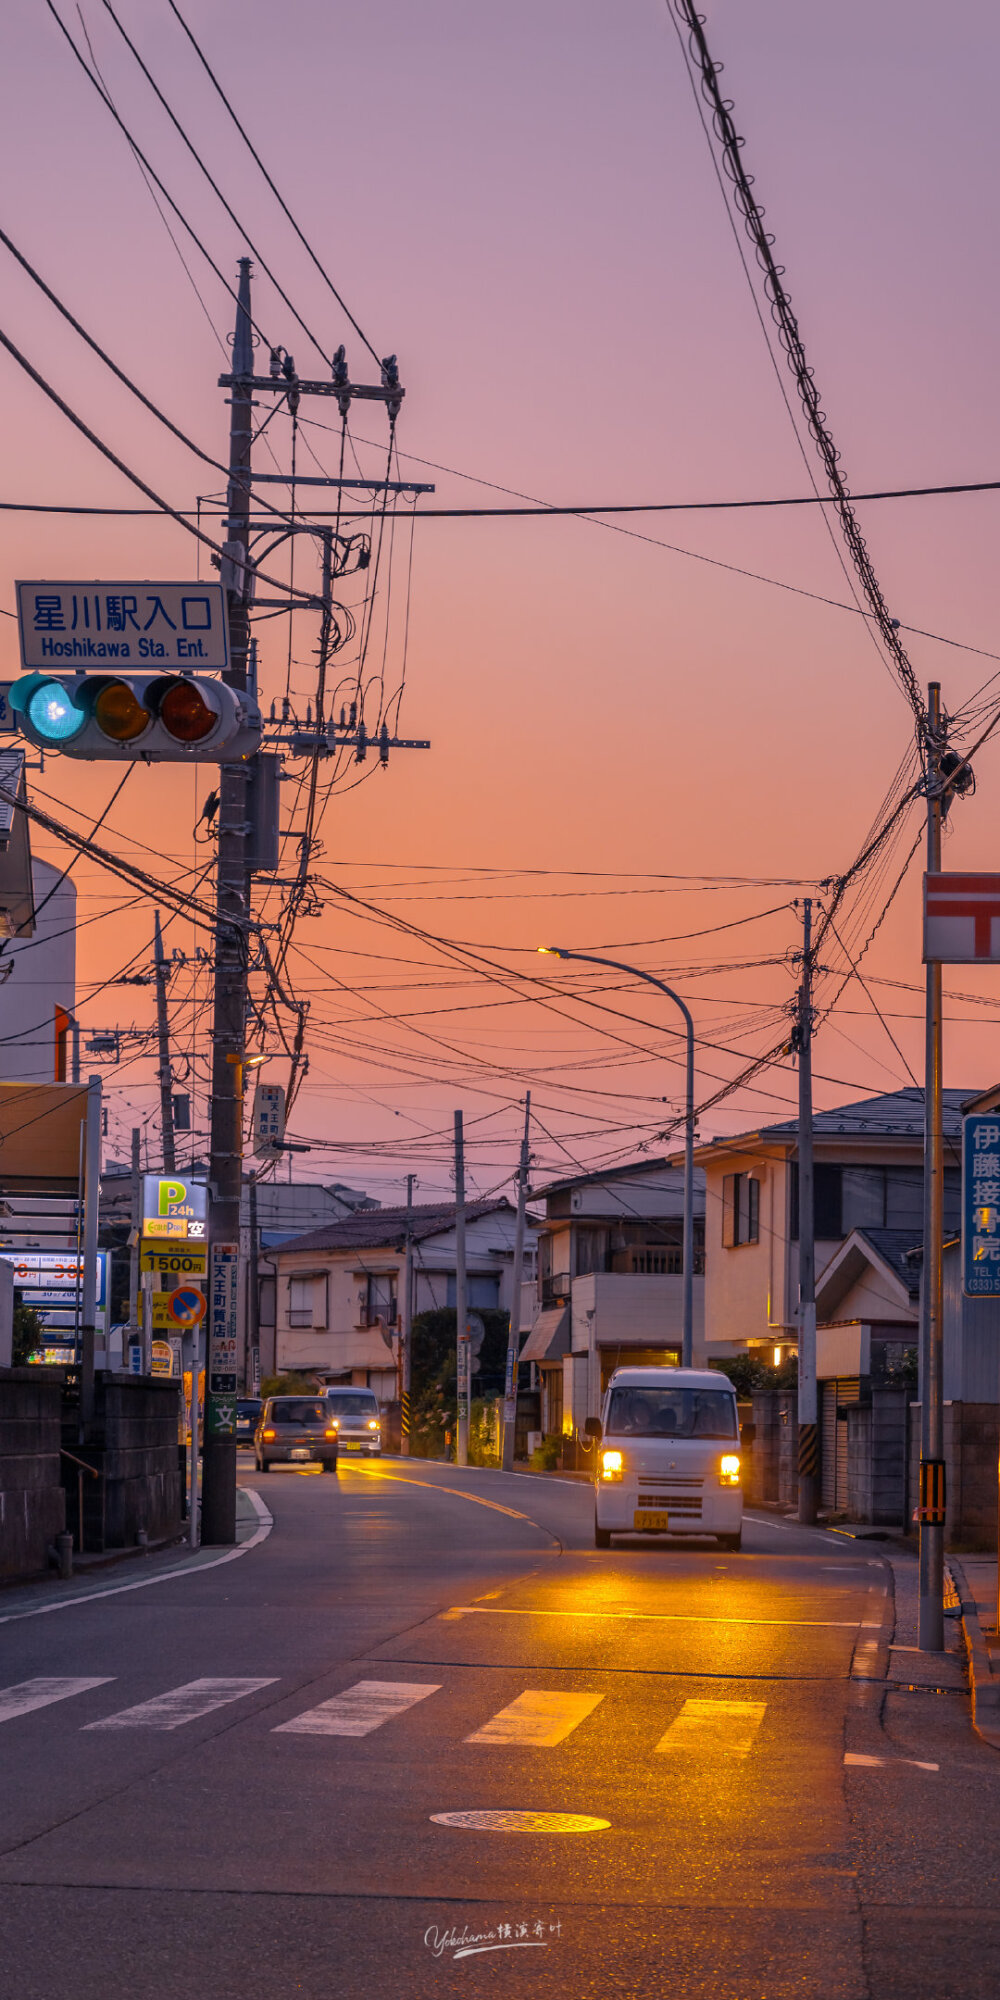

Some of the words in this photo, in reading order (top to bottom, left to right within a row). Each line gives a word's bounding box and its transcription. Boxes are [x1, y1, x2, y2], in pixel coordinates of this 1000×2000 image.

[33, 595, 212, 632] 星川駅入口
[42, 638, 130, 657] Hoshikawa
[138, 638, 169, 658] Sta.
[177, 638, 208, 658] Ent.
[158, 1181, 186, 1216] P
[170, 1205, 194, 1216] 24h
[187, 1221, 205, 1237] 空
[148, 1257, 202, 1272] 1500円
[973, 1267, 992, 1277] TEL
[214, 1265, 226, 1337] 天王町質店
[214, 1405, 234, 1427] 文
